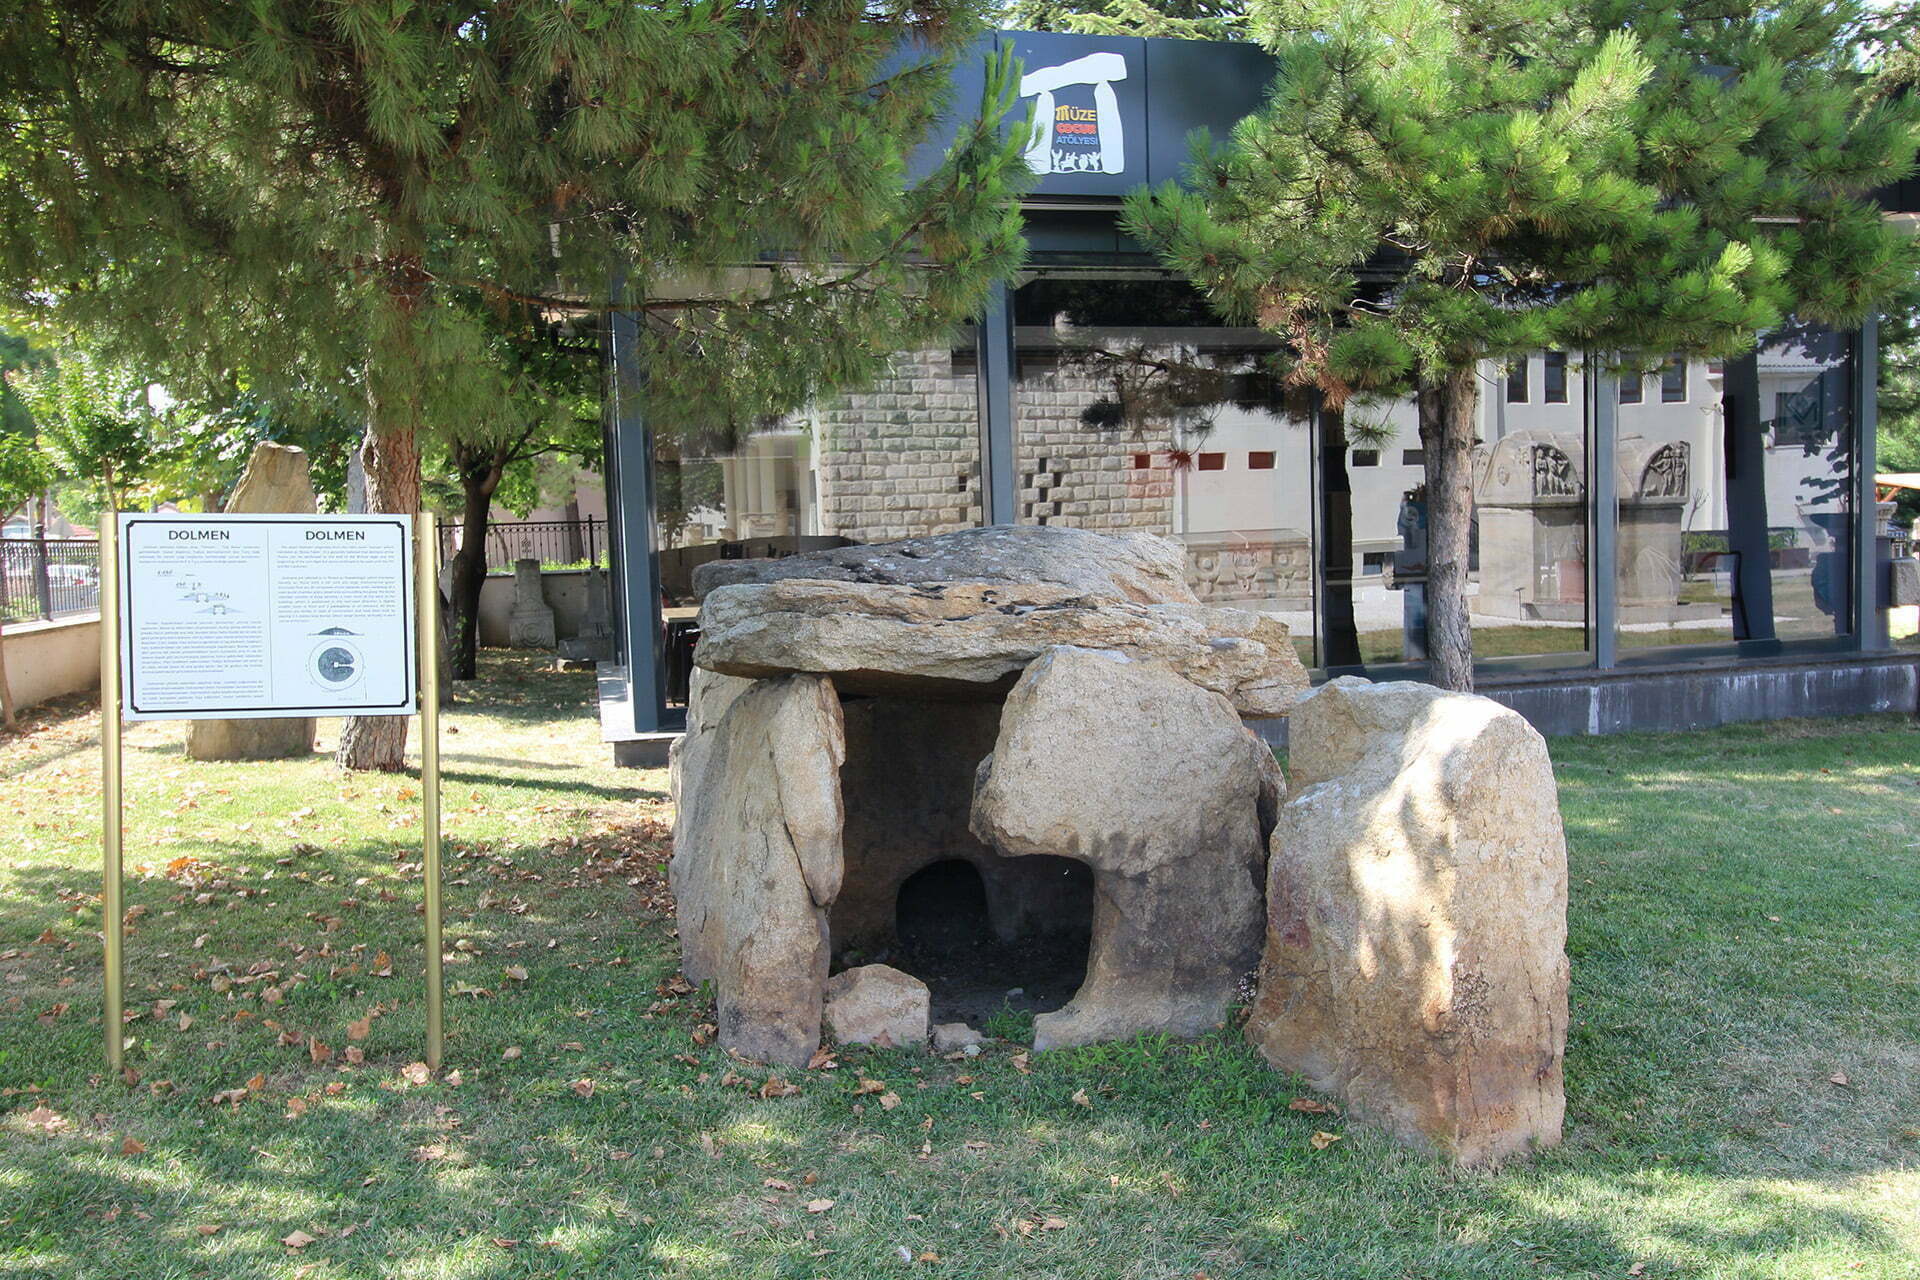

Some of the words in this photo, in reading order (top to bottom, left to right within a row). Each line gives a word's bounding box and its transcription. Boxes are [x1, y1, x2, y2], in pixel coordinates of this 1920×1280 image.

[1055, 105, 1097, 121] MÜZE
[168, 530, 230, 541] DOLMEN
[305, 530, 366, 541] DOLMEN
